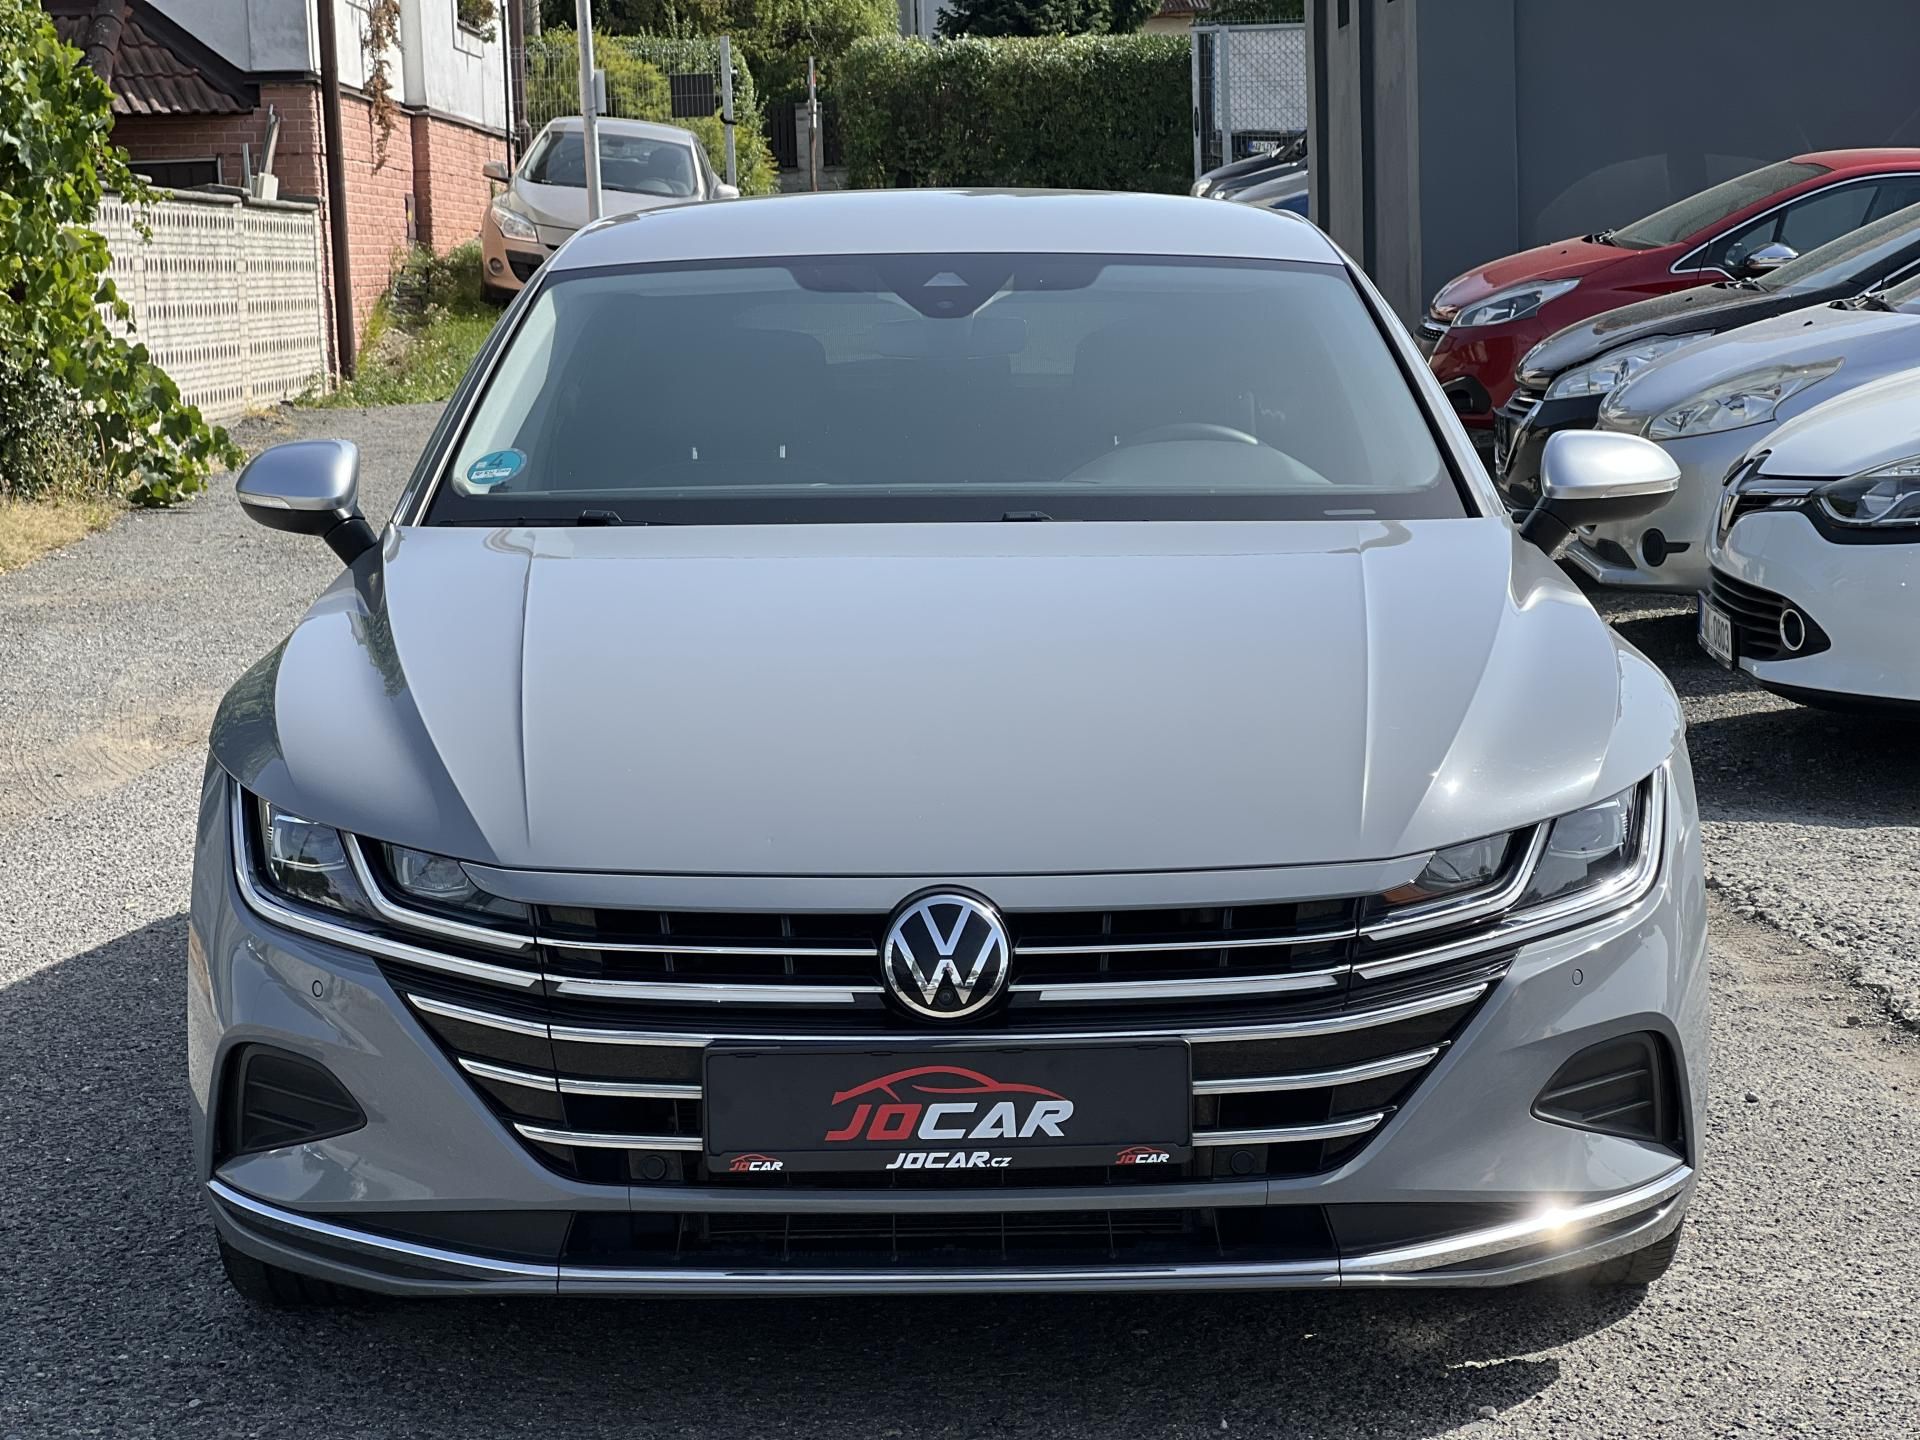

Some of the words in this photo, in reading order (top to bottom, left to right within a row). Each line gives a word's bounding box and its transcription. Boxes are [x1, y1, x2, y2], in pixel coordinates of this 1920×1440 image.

[889, 898, 1003, 1010] VW
[826, 1100, 1074, 1141] JOCAR
[729, 1160, 784, 1172] JOCAR
[1116, 1152, 1170, 1165] JOCAR
